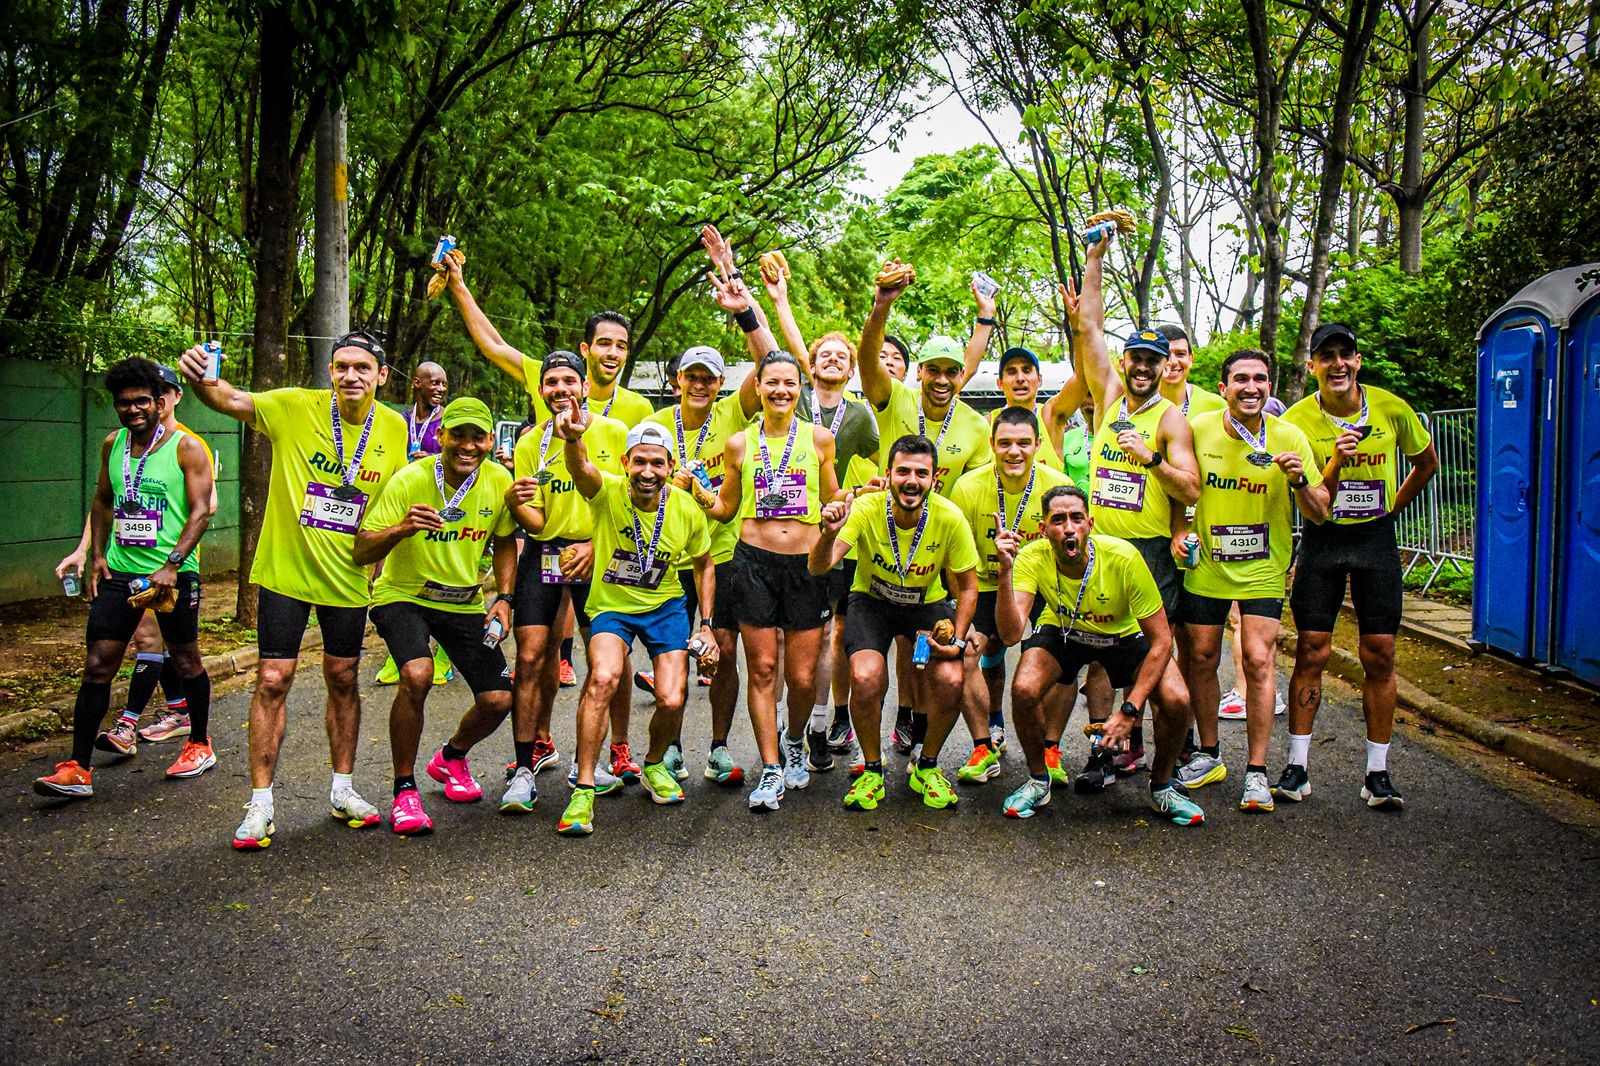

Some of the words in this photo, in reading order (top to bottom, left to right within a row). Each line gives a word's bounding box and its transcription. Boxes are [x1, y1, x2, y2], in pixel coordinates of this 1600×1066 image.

[334, 428, 342, 441] RUN
[355, 430, 369, 460] ATHENAS
[365, 416, 373, 431] RUN
[676, 421, 684, 443] LONGER
[678, 444, 686, 458] 21.1K
[778, 447, 792, 475] ATHENAS
[787, 436, 795, 447] RUN
[309, 451, 381, 483] Runun
[760, 445, 771, 469] THENAS
[766, 468, 774, 481] RUN
[1108, 483, 1135, 494] 3637
[1206, 472, 1268, 494] RunFun
[781, 490, 802, 499] 857
[1345, 494, 1374, 503] 3615
[323, 502, 354, 517] 3273
[1012, 507, 1025, 532] ATHENAS
[1021, 493, 1030, 506] RUN
[125, 523, 152, 531] 3496
[651, 520, 663, 549] ATHENAS
[657, 507, 665, 521] RUN
[1230, 538, 1258, 547] 4310
